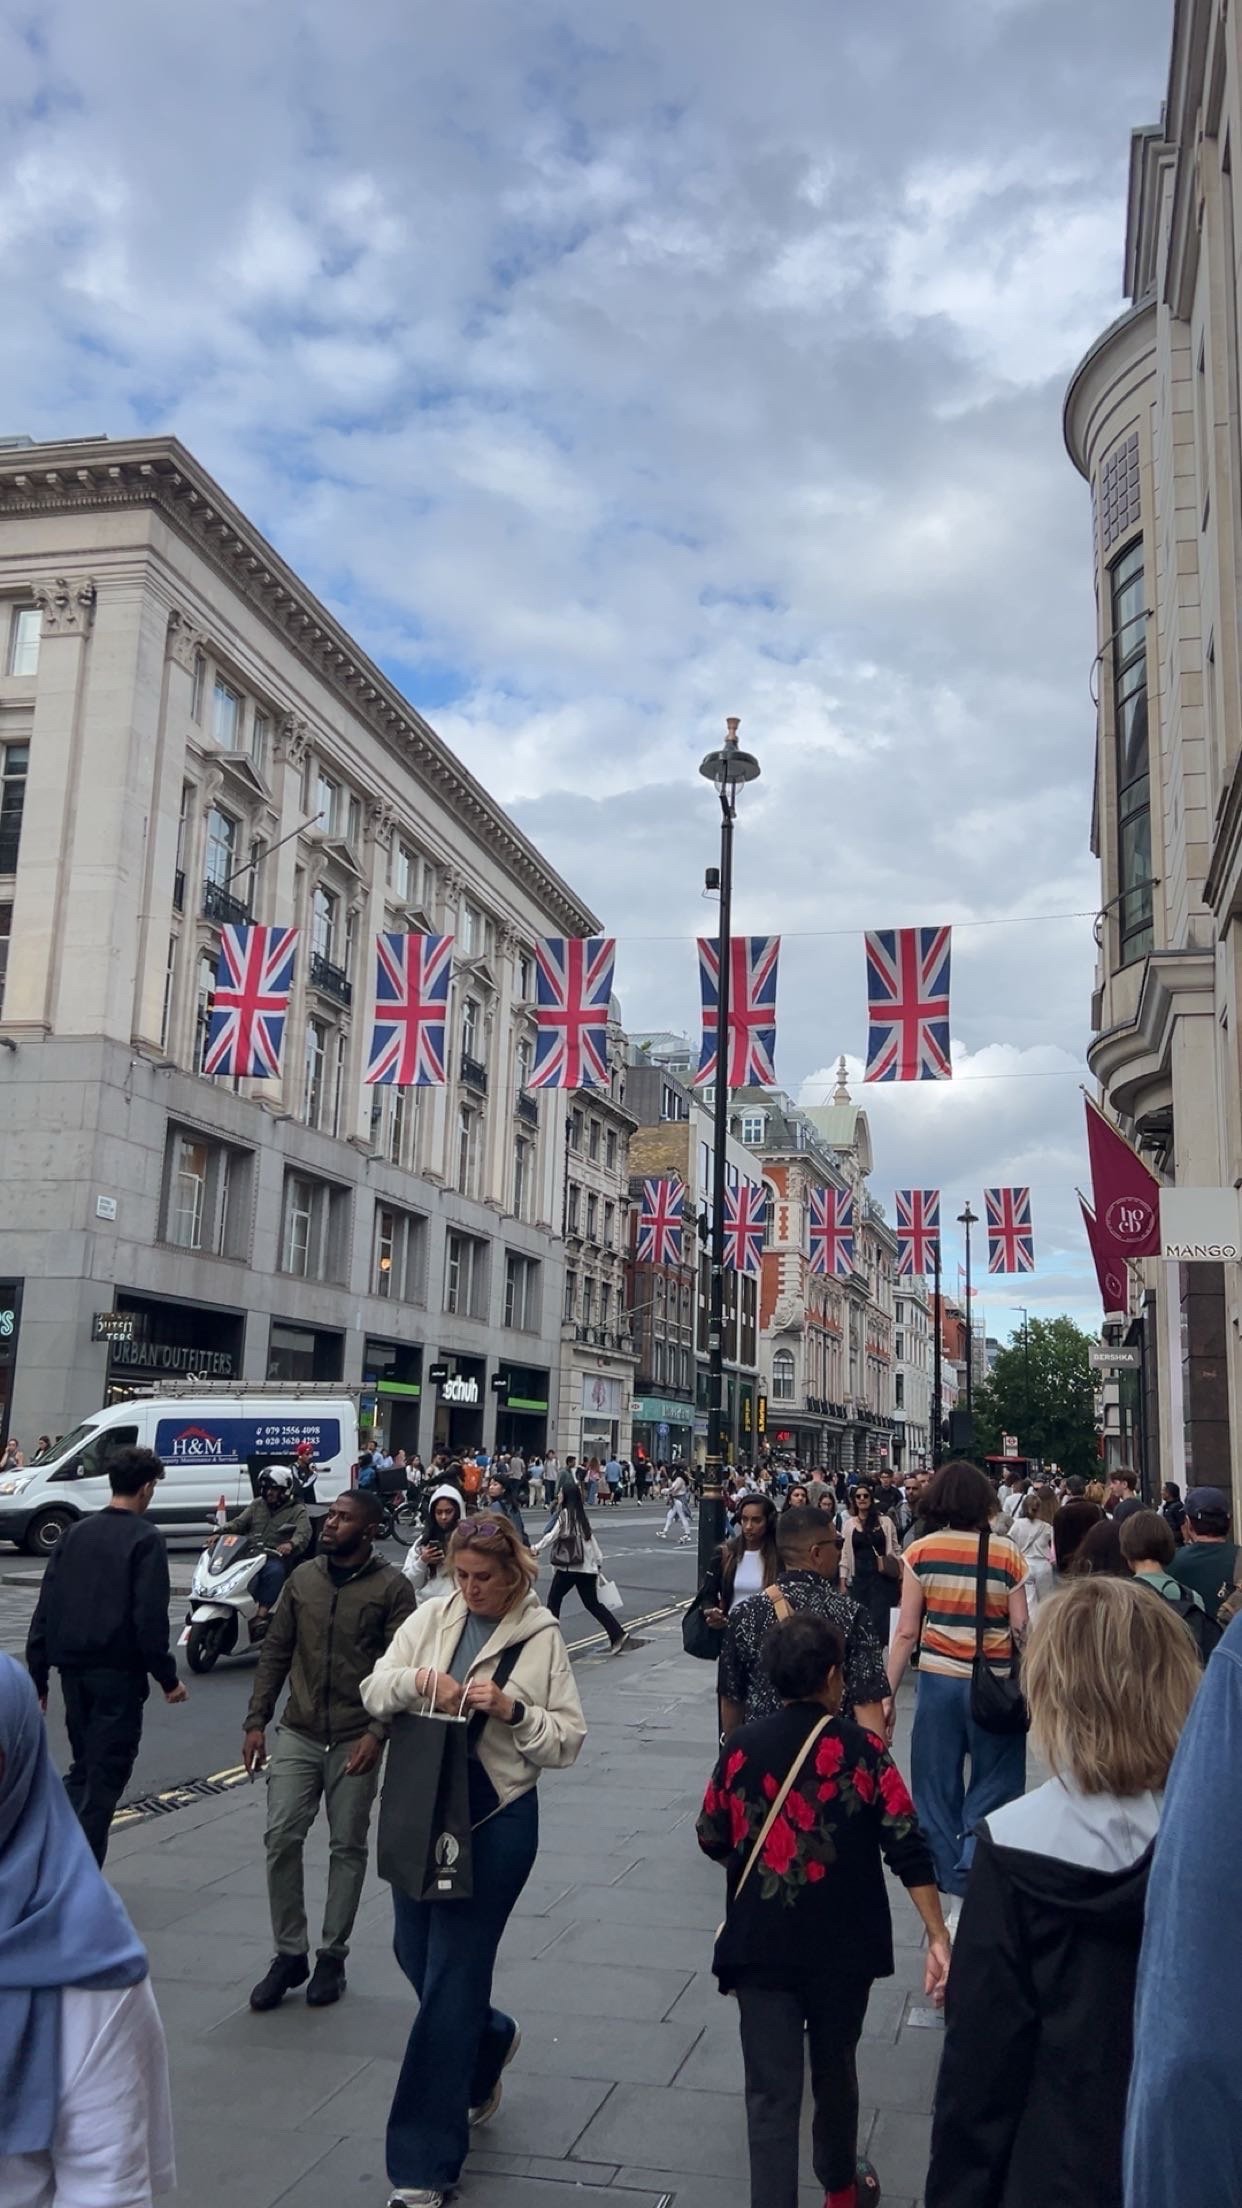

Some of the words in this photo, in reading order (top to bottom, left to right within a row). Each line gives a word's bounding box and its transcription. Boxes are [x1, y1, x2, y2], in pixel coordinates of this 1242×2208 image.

[1166, 1245, 1236, 1258] MANGO
[0, 1310, 14, 1336] S
[112, 1342, 158, 1367] URBAN
[162, 1346, 232, 1374] OUTFITTERS
[1093, 1353, 1134, 1361] BERSHKA
[442, 1374, 478, 1403] schuh
[265, 1426, 280, 1435] 079
[281, 1426, 300, 1435] 2556
[301, 1426, 320, 1435] 4098
[172, 1438, 223, 1455] H&M
[265, 1437, 280, 1446] 020
